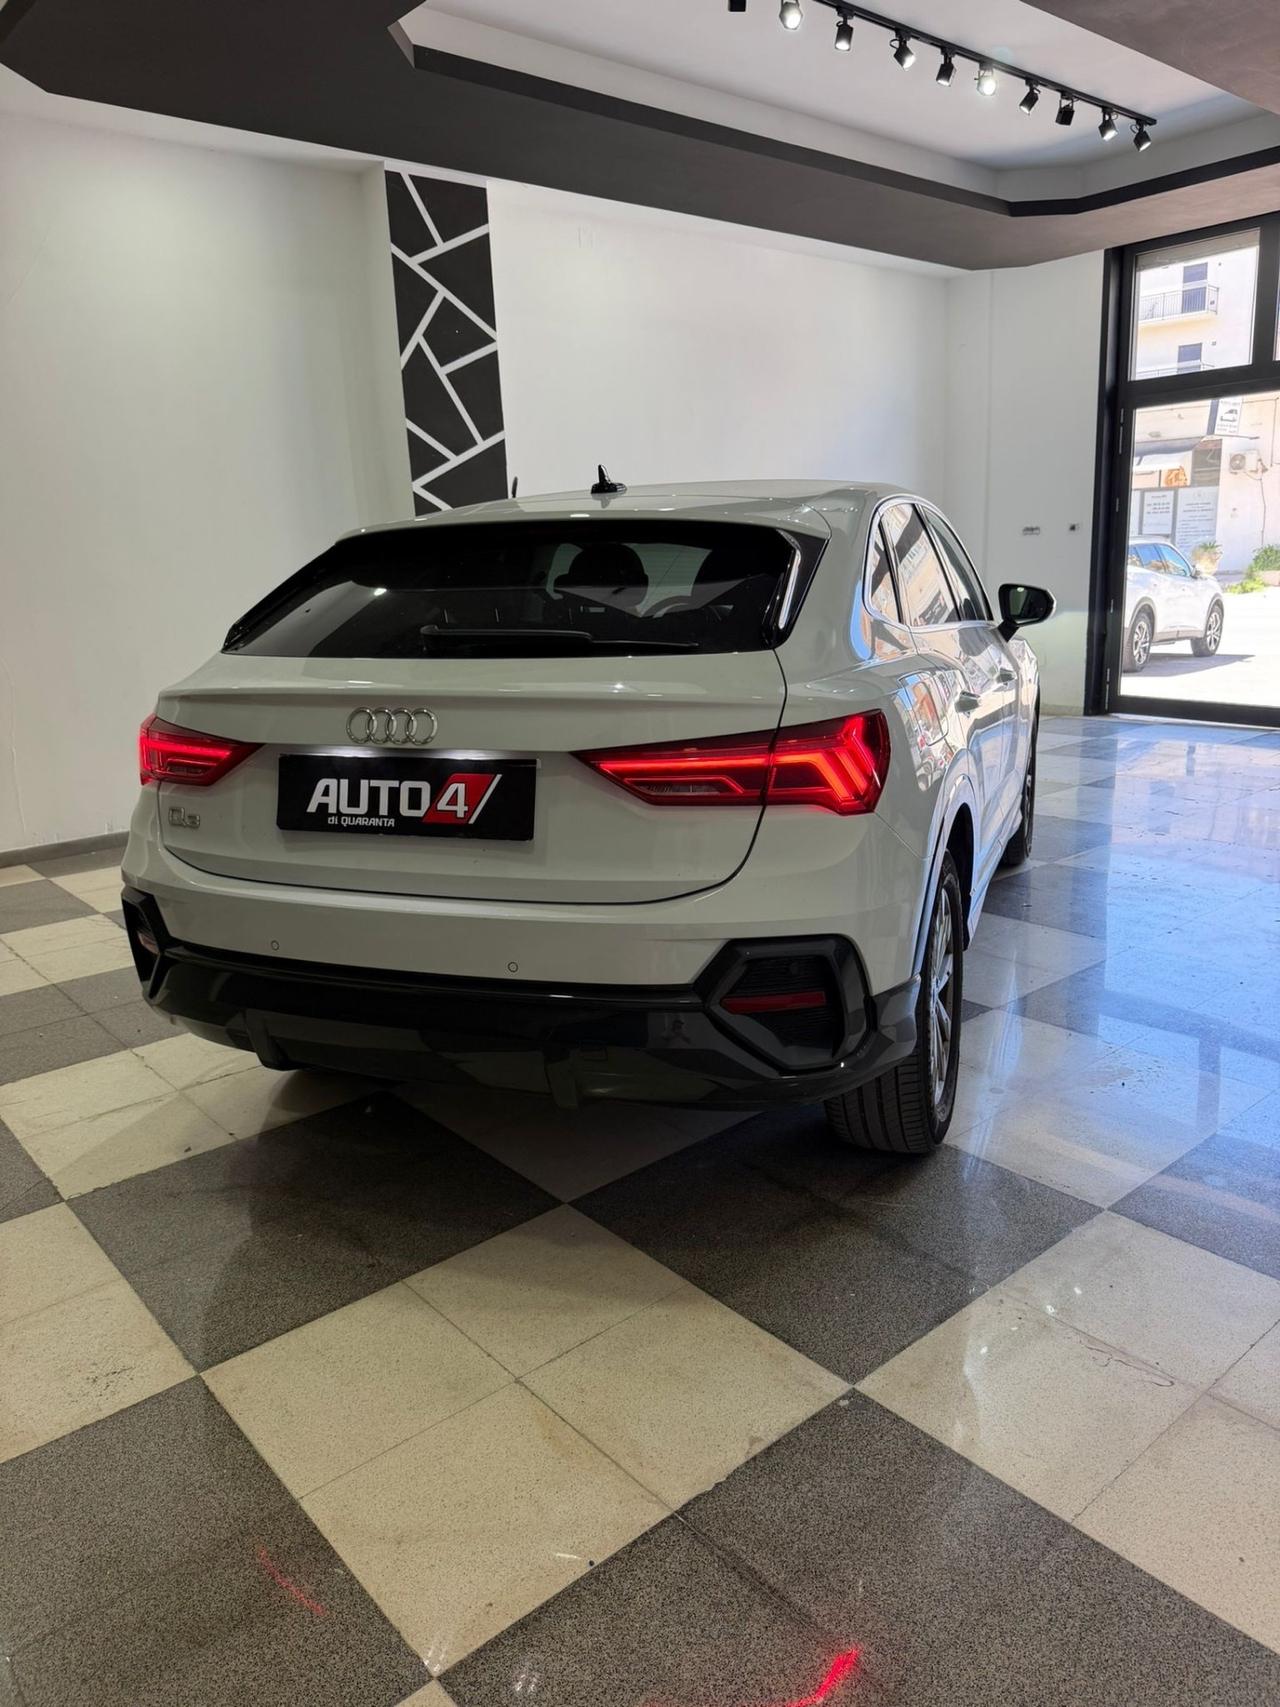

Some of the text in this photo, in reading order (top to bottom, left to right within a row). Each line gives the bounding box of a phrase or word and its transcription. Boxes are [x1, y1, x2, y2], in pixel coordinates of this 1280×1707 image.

[168, 806, 201, 829] Q3
[327, 816, 395, 828] di QUARANTA
